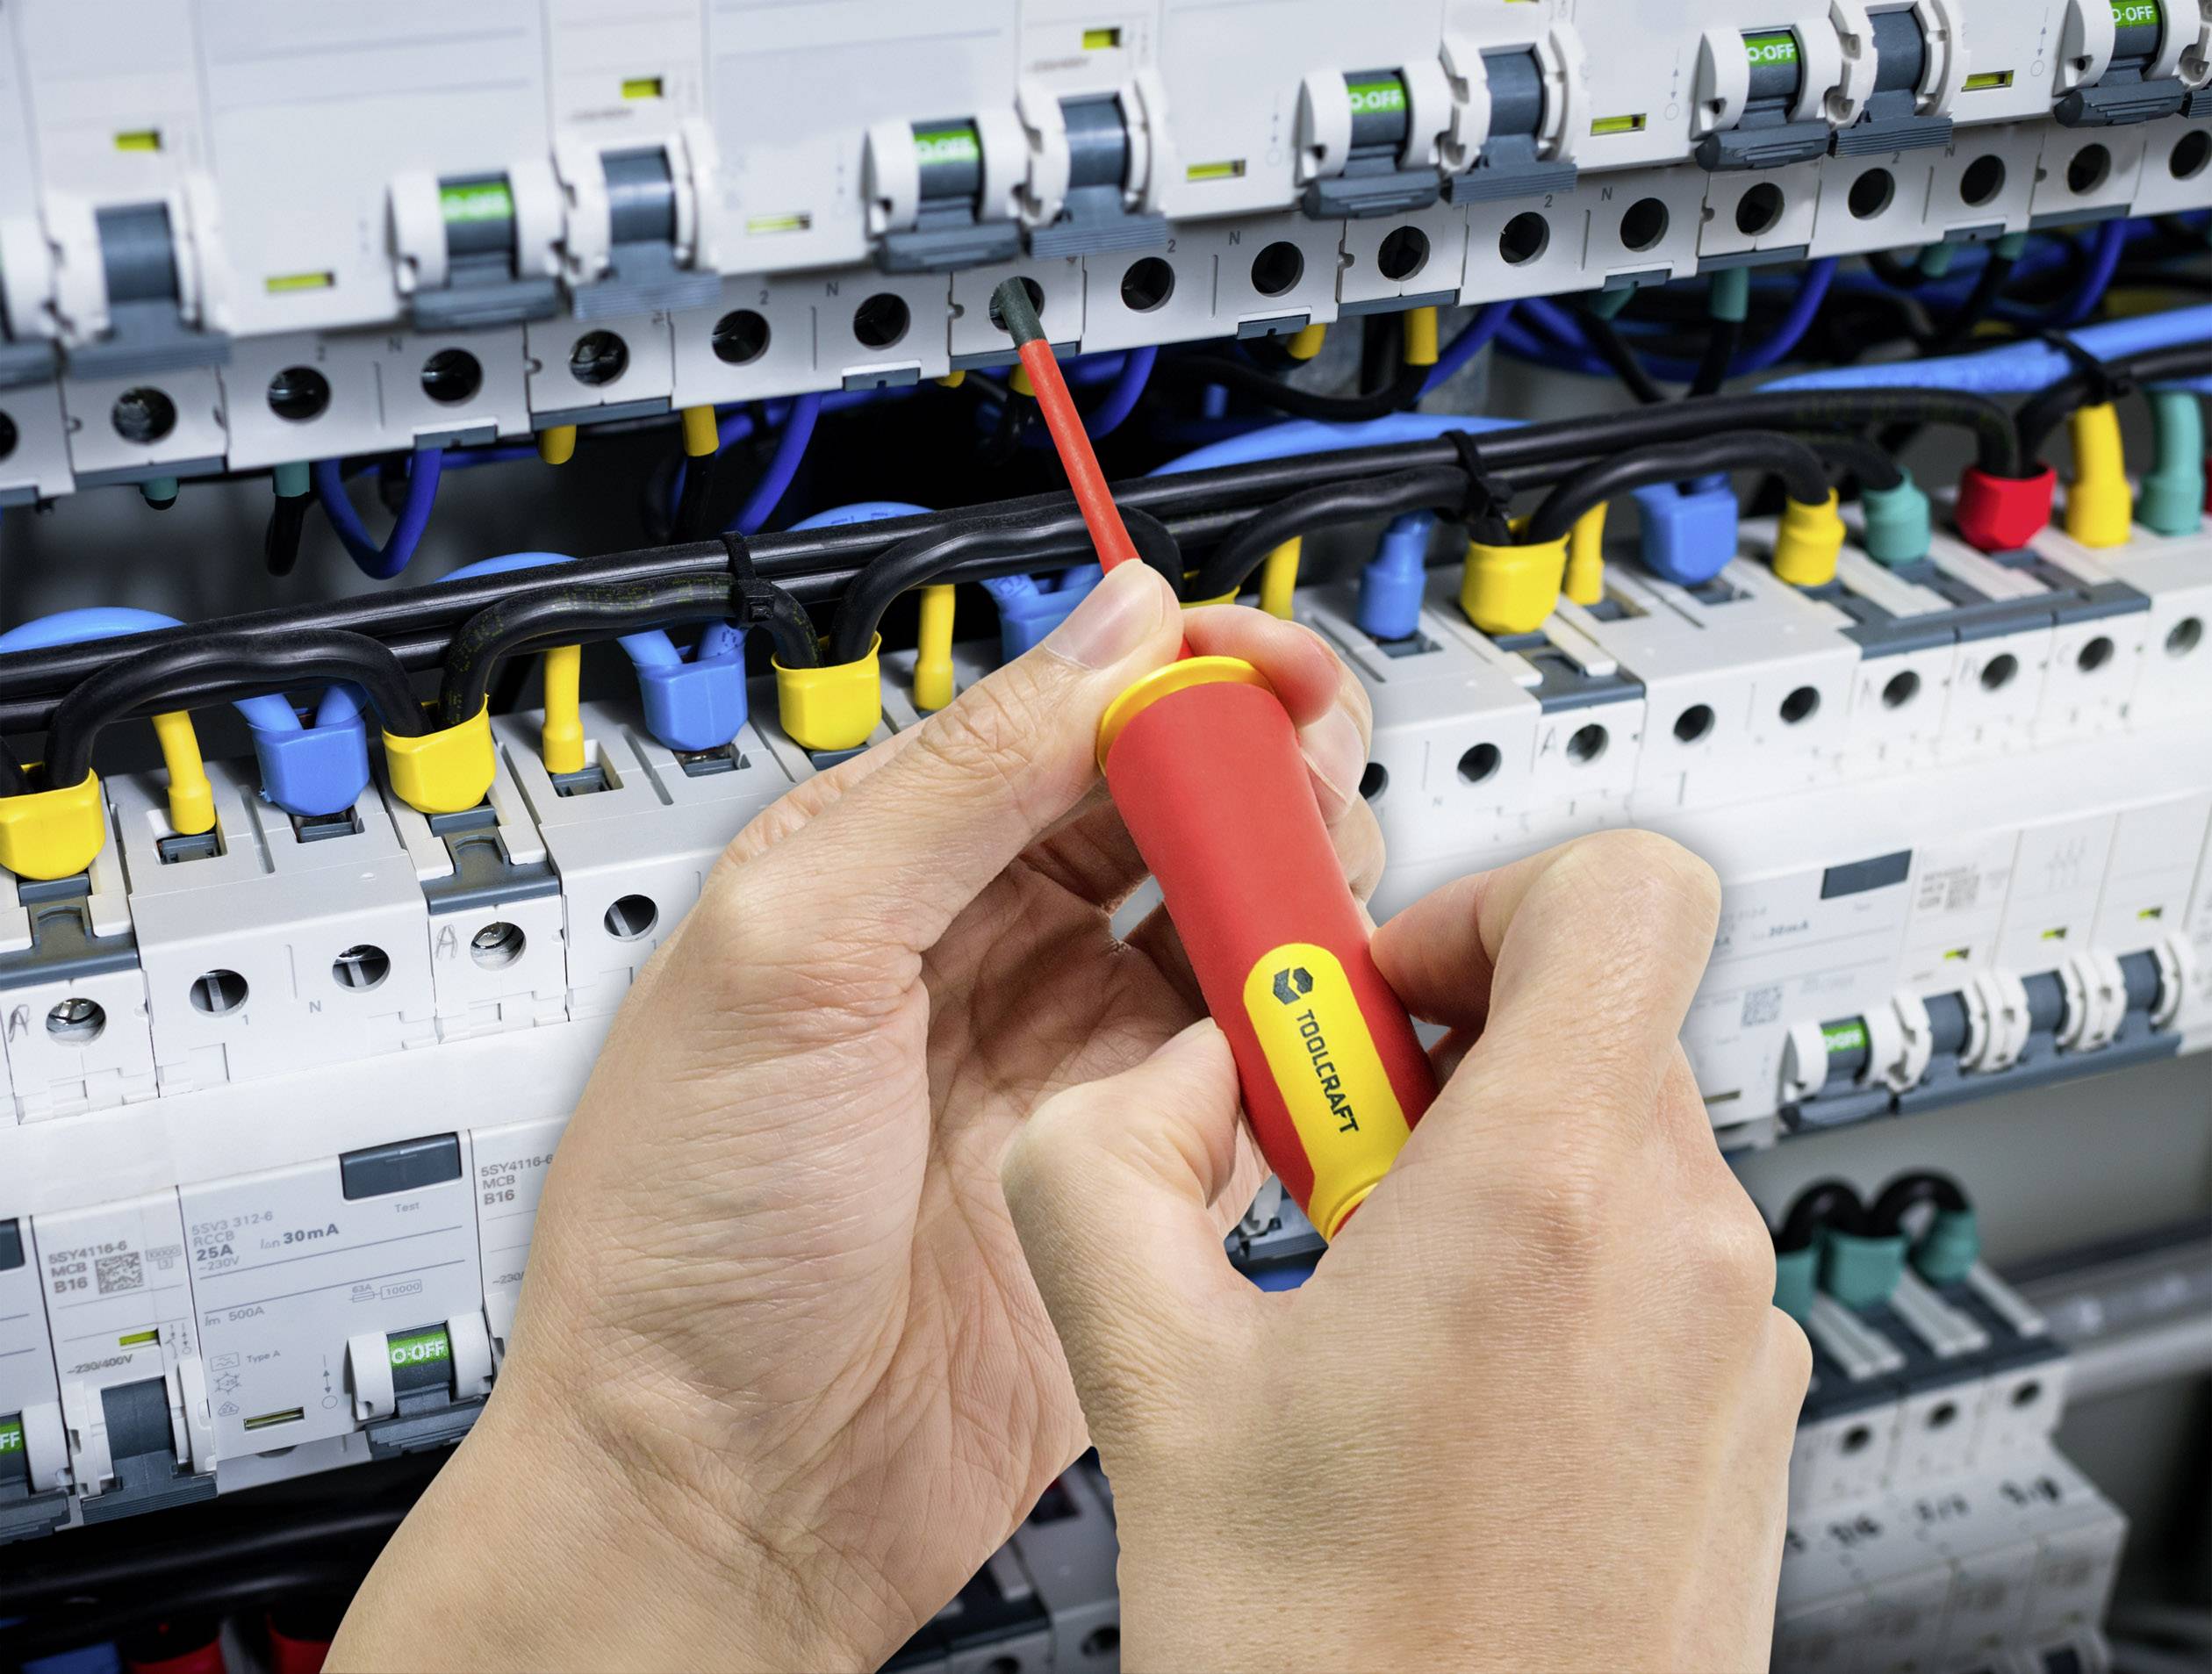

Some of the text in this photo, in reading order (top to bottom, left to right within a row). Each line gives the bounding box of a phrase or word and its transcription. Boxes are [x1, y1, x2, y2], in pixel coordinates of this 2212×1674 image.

[1544, 194, 1553, 208] 2
[1601, 186, 1613, 201] N
[1167, 239, 1176, 253] 2
[1229, 230, 1240, 246] N
[826, 281, 839, 297] N
[759, 290, 769, 305] 2
[309, 1000, 322, 1014] N
[1296, 1009, 1360, 1133] TOOLCRAFT
[483, 1175, 515, 1189] MCB
[484, 1189, 515, 1205] B16
[394, 1202, 420, 1212] Test
[193, 1231, 234, 1247] RCCB
[283, 1223, 340, 1245] 30mA
[197, 1244, 233, 1261] 25A
[51, 1261, 87, 1278] MCB
[54, 1276, 88, 1294] B16
[386, 1282, 420, 1296] 10000
[228, 1305, 265, 1321] 500A
[247, 1349, 281, 1363] Type A
